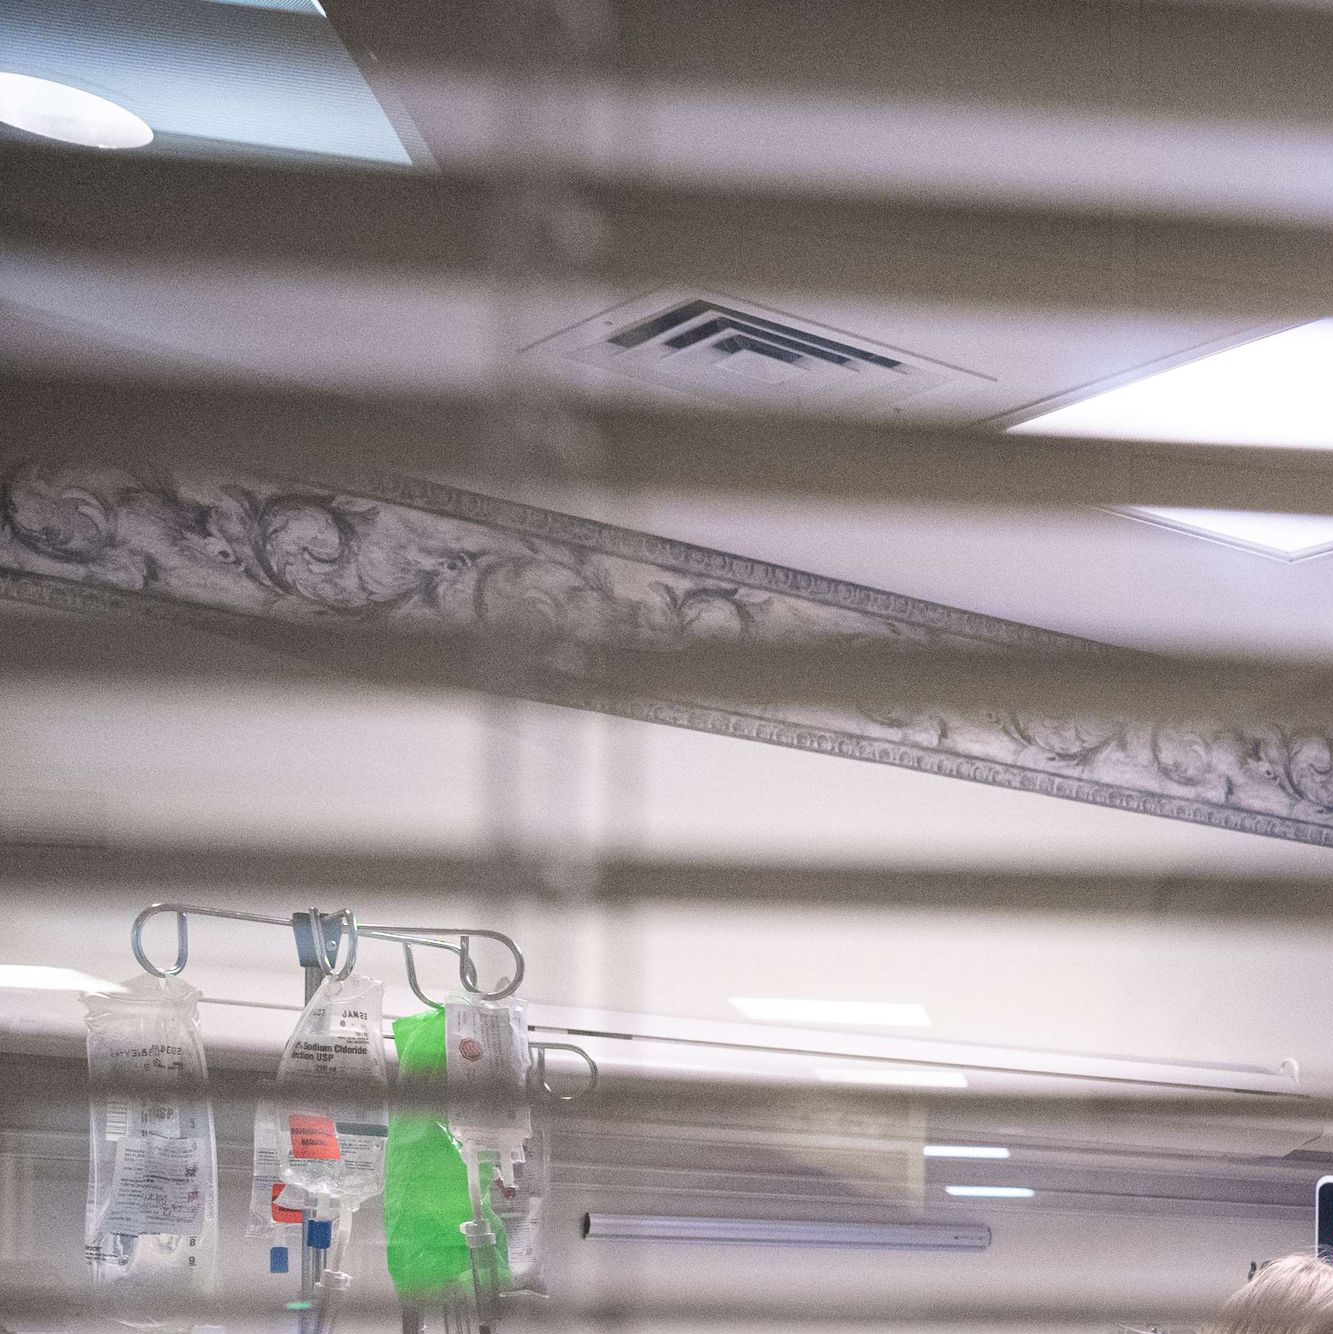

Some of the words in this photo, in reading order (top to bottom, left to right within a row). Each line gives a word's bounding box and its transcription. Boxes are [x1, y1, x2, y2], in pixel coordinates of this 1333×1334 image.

[303, 1042, 332, 1053] Sodium
[334, 1044, 368, 1056] Chloride
[316, 1053, 335, 1063] USP
